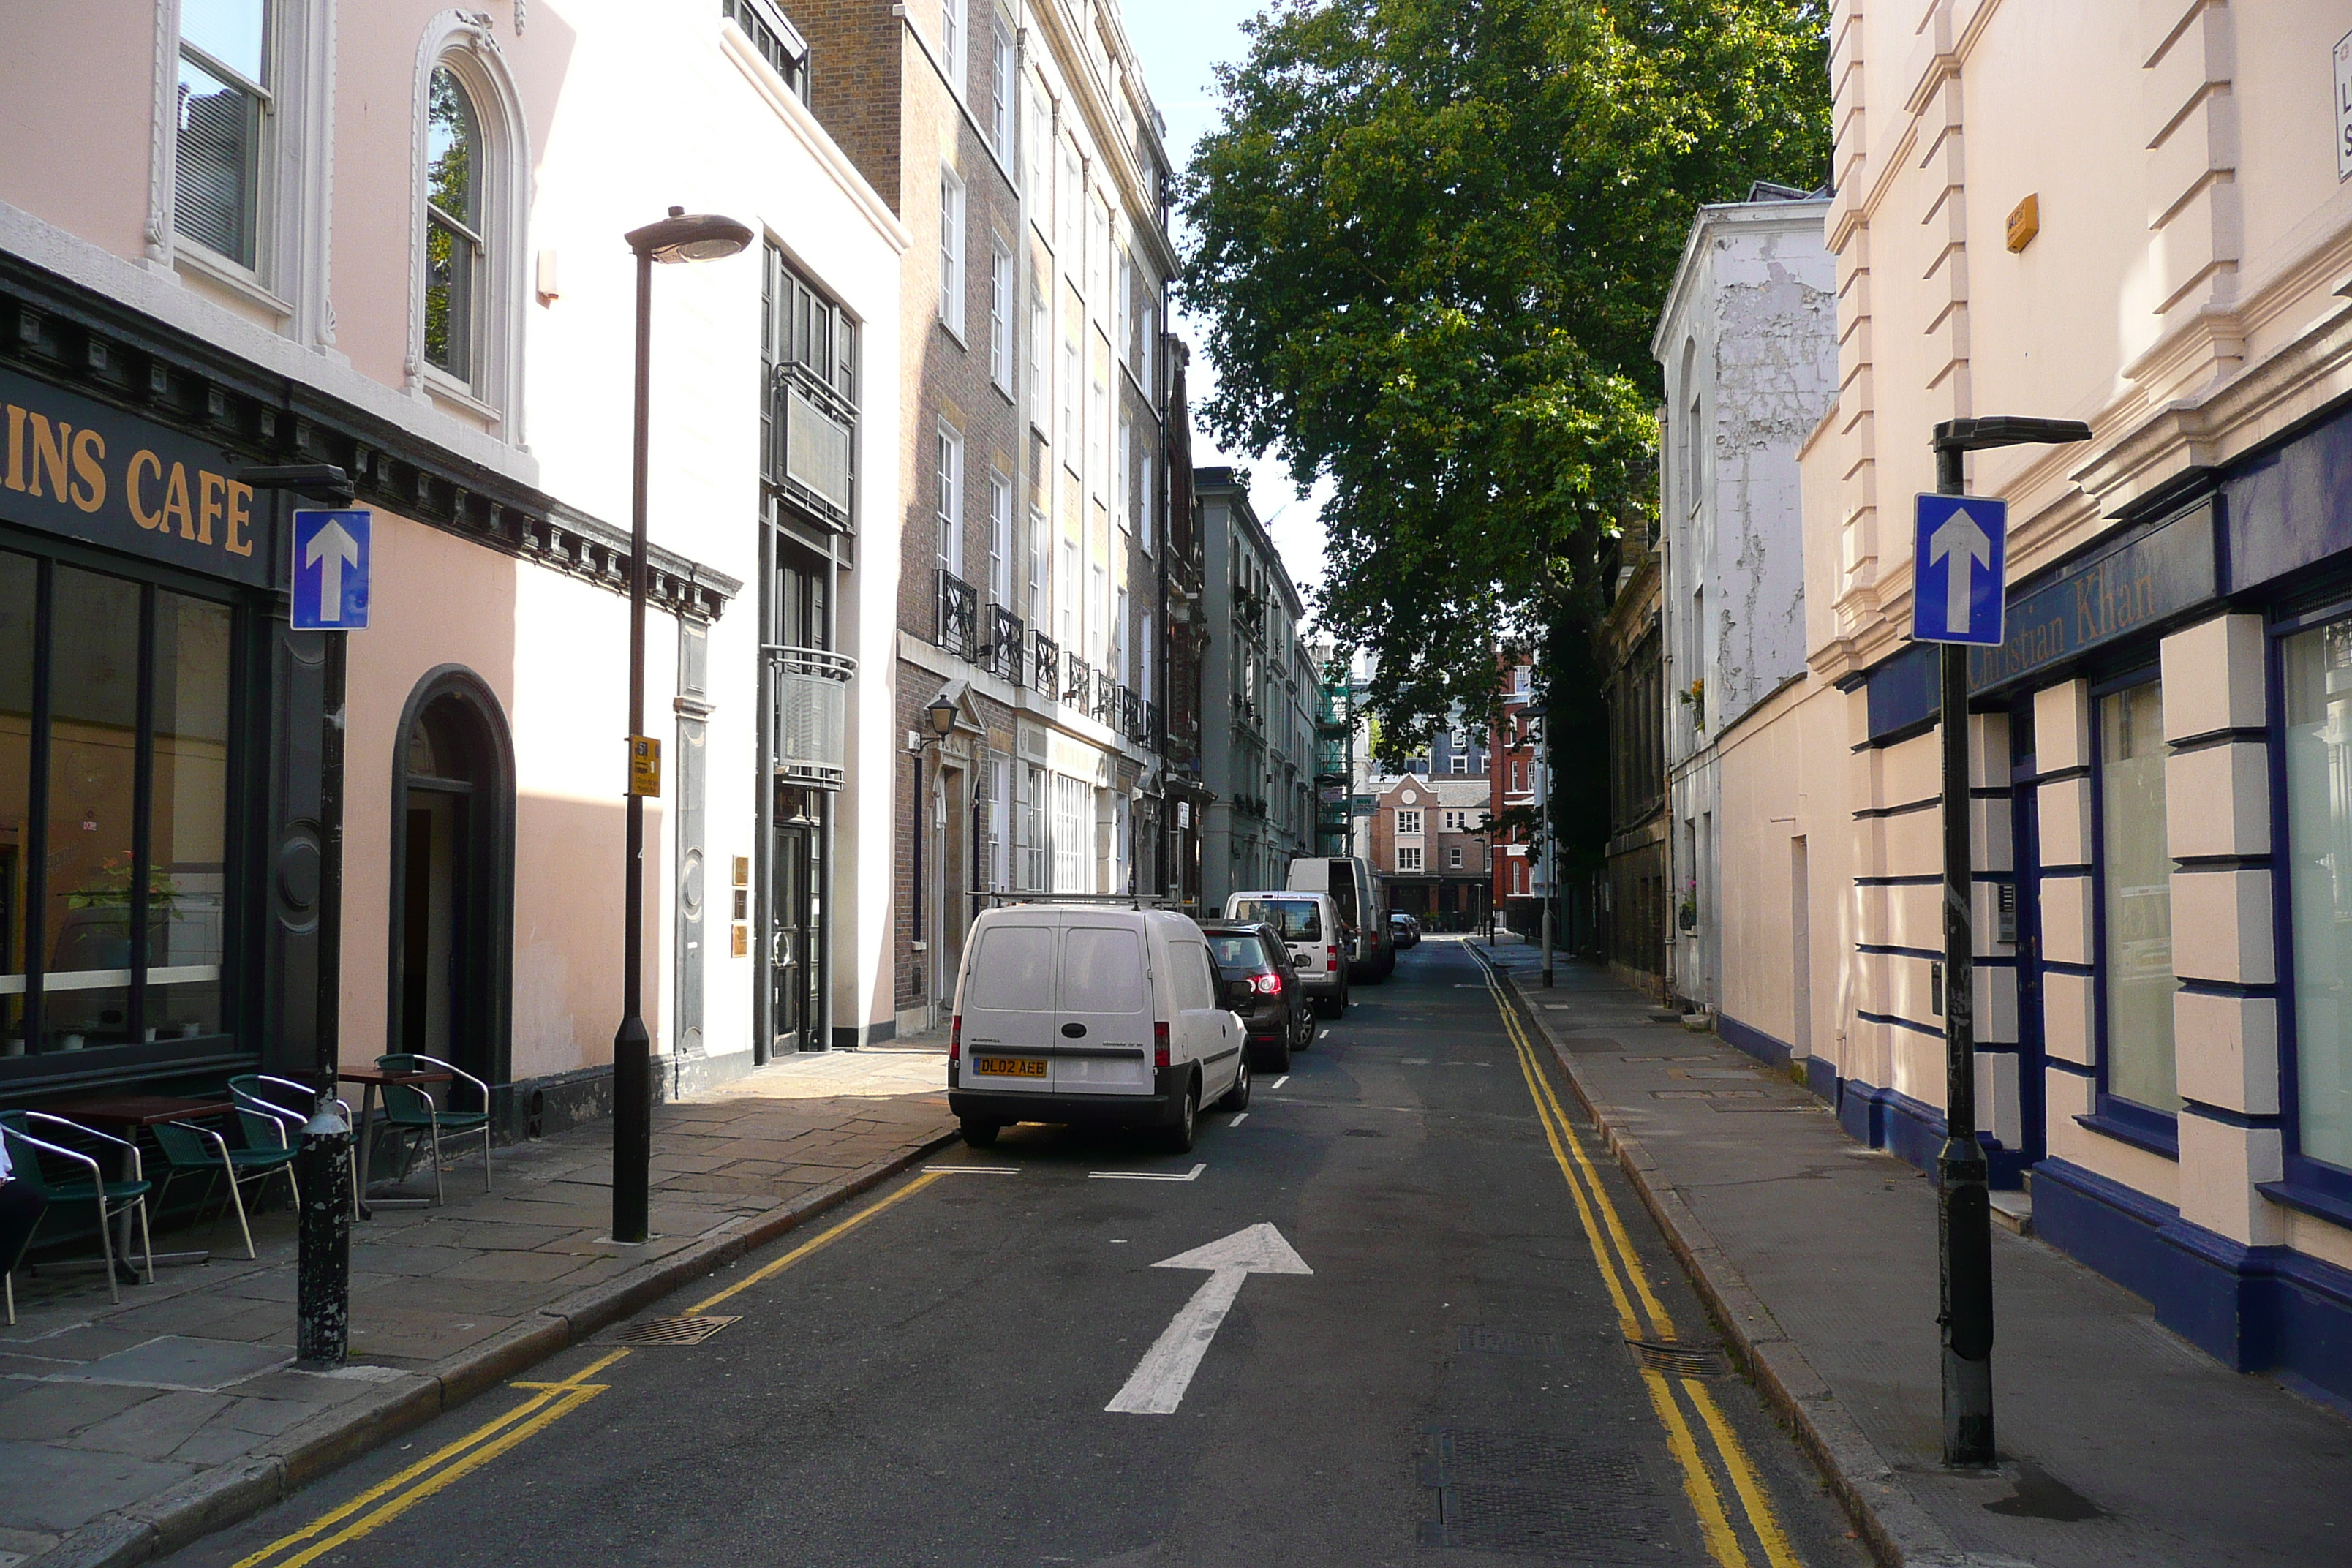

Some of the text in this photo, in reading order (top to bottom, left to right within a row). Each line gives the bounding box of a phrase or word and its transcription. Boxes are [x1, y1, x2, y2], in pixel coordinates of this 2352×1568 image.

[0, 404, 253, 557] INS CAFE
[2073, 562, 2156, 645] Khan
[981, 1059, 1016, 1074] DL02
